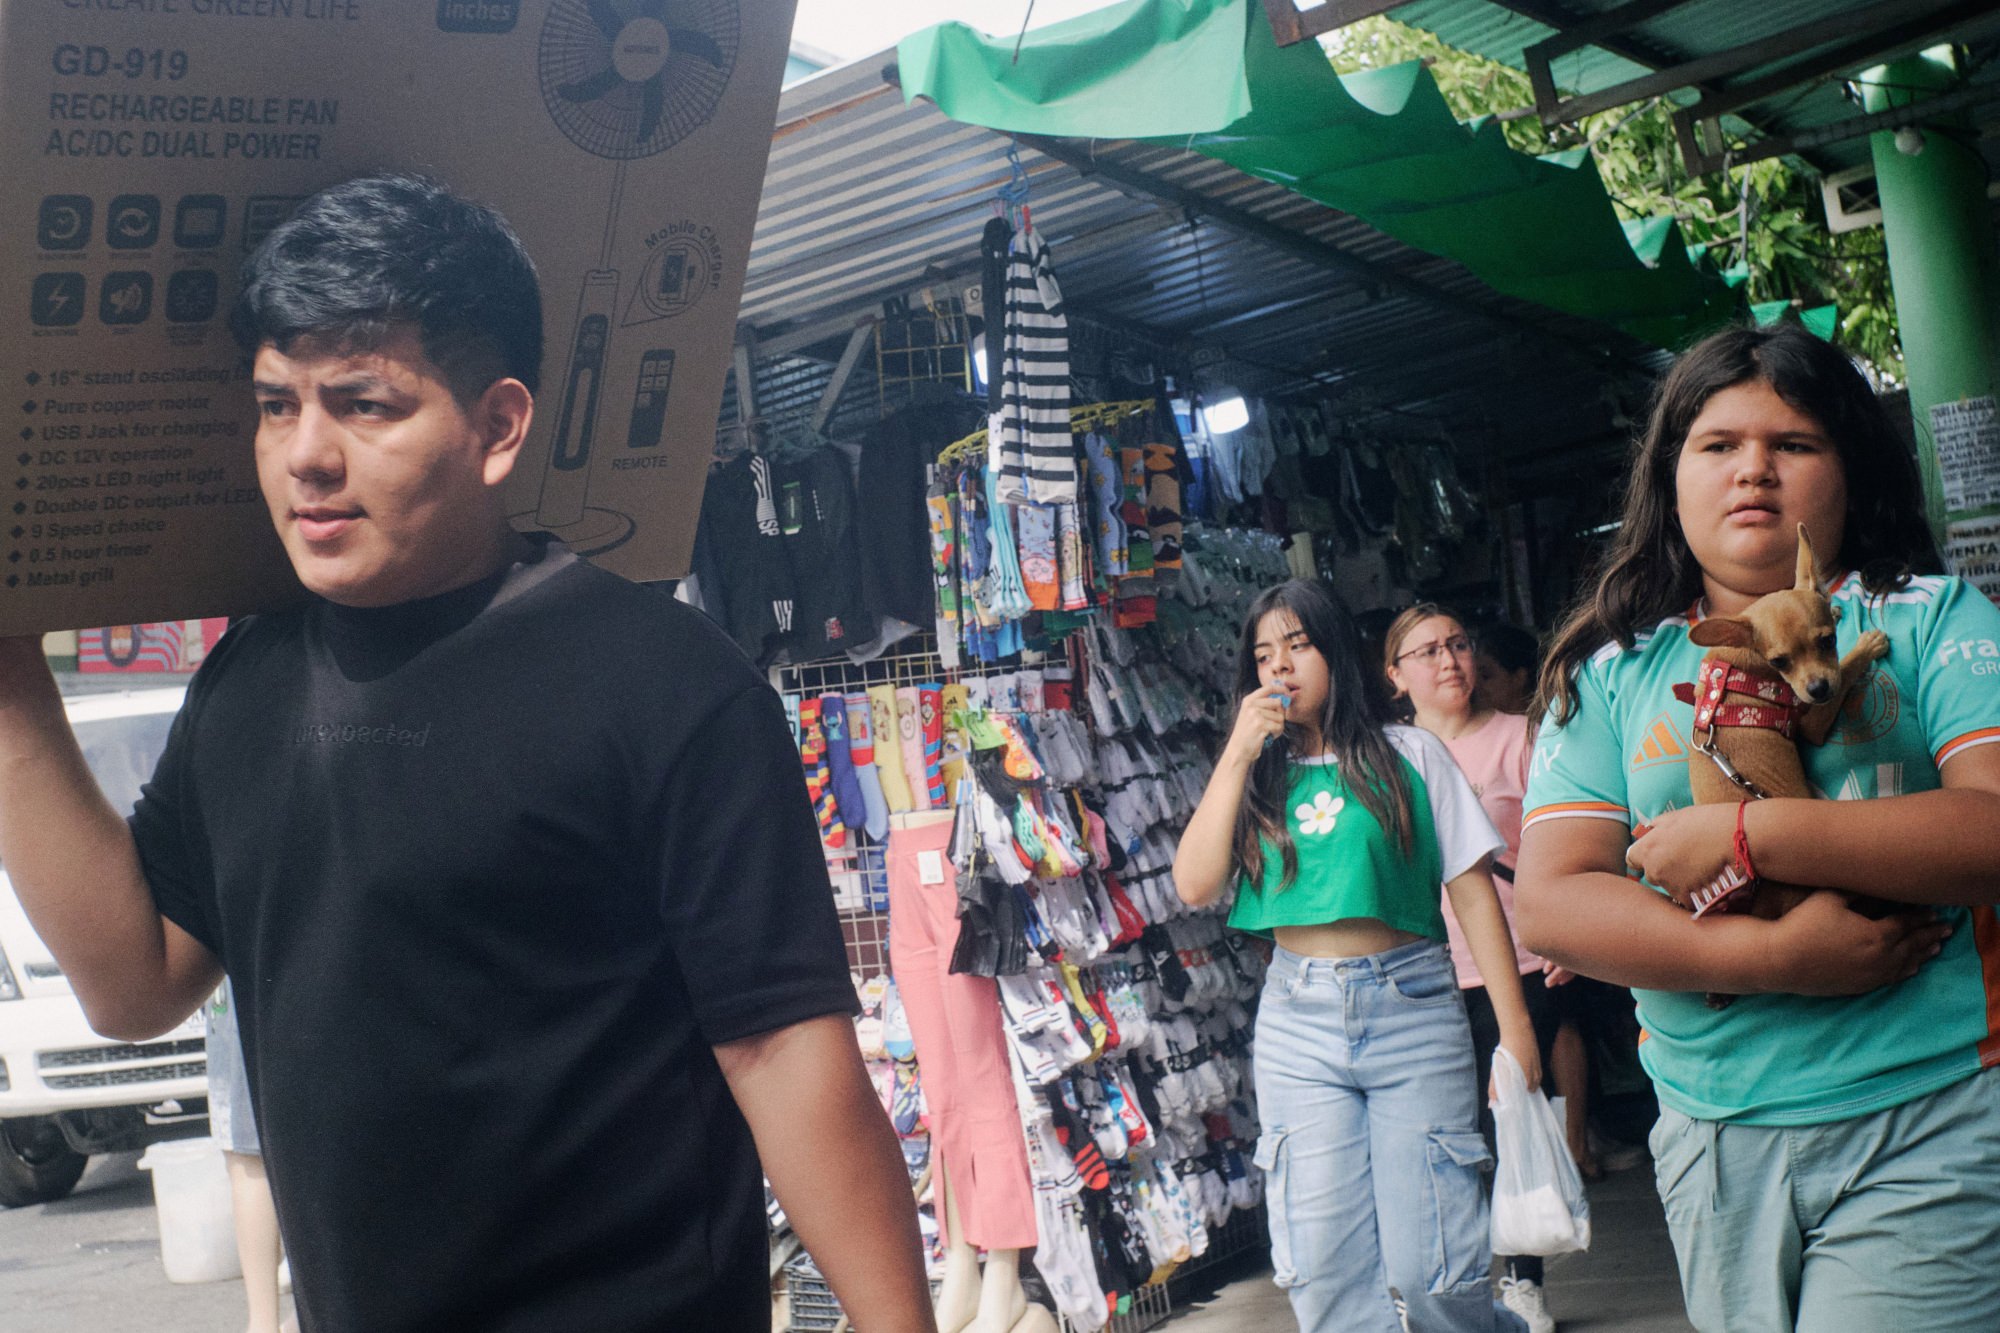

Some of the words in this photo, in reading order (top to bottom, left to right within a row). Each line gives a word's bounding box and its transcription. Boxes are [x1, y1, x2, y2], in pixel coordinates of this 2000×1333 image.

[445, 0, 514, 20] inches
[52, 44, 189, 80] GD-919
[50, 93, 279, 124] RECHARGEABLE
[287, 98, 339, 125] FAN
[46, 129, 134, 157] AC/DC
[142, 130, 216, 159] DUAL
[223, 132, 322, 160] POWER
[644, 219, 697, 249] Mobile
[83, 369, 134, 385] stand
[44, 399, 87, 415] Pure
[92, 398, 155, 416] copper
[159, 395, 209, 411] motor
[42, 425, 81, 441] USB
[87, 423, 128, 440] Jack
[133, 422, 159, 438] for
[163, 420, 240, 438] charging
[39, 451, 66, 466] DC
[74, 448, 104, 464] 12V
[110, 446, 194, 464] operation
[611, 455, 668, 471] REMOTE
[36, 475, 90, 492] 20pcs
[95, 471, 132, 488] LED
[137, 469, 182, 488] night
[187, 466, 225, 486] light
[34, 498, 97, 515] Double
[103, 495, 129, 511] DC
[134, 492, 190, 511] output
[224, 487, 258, 505] LED
[47, 520, 103, 540] Speed
[108, 518, 167, 535] choice
[61, 546, 101, 561] hour
[106, 543, 152, 558] timer
[1945, 541, 1999, 559] VENTA
[27, 570, 76, 587] Metal
[80, 566, 114, 588] grill
[1971, 661, 2000, 676] GR
